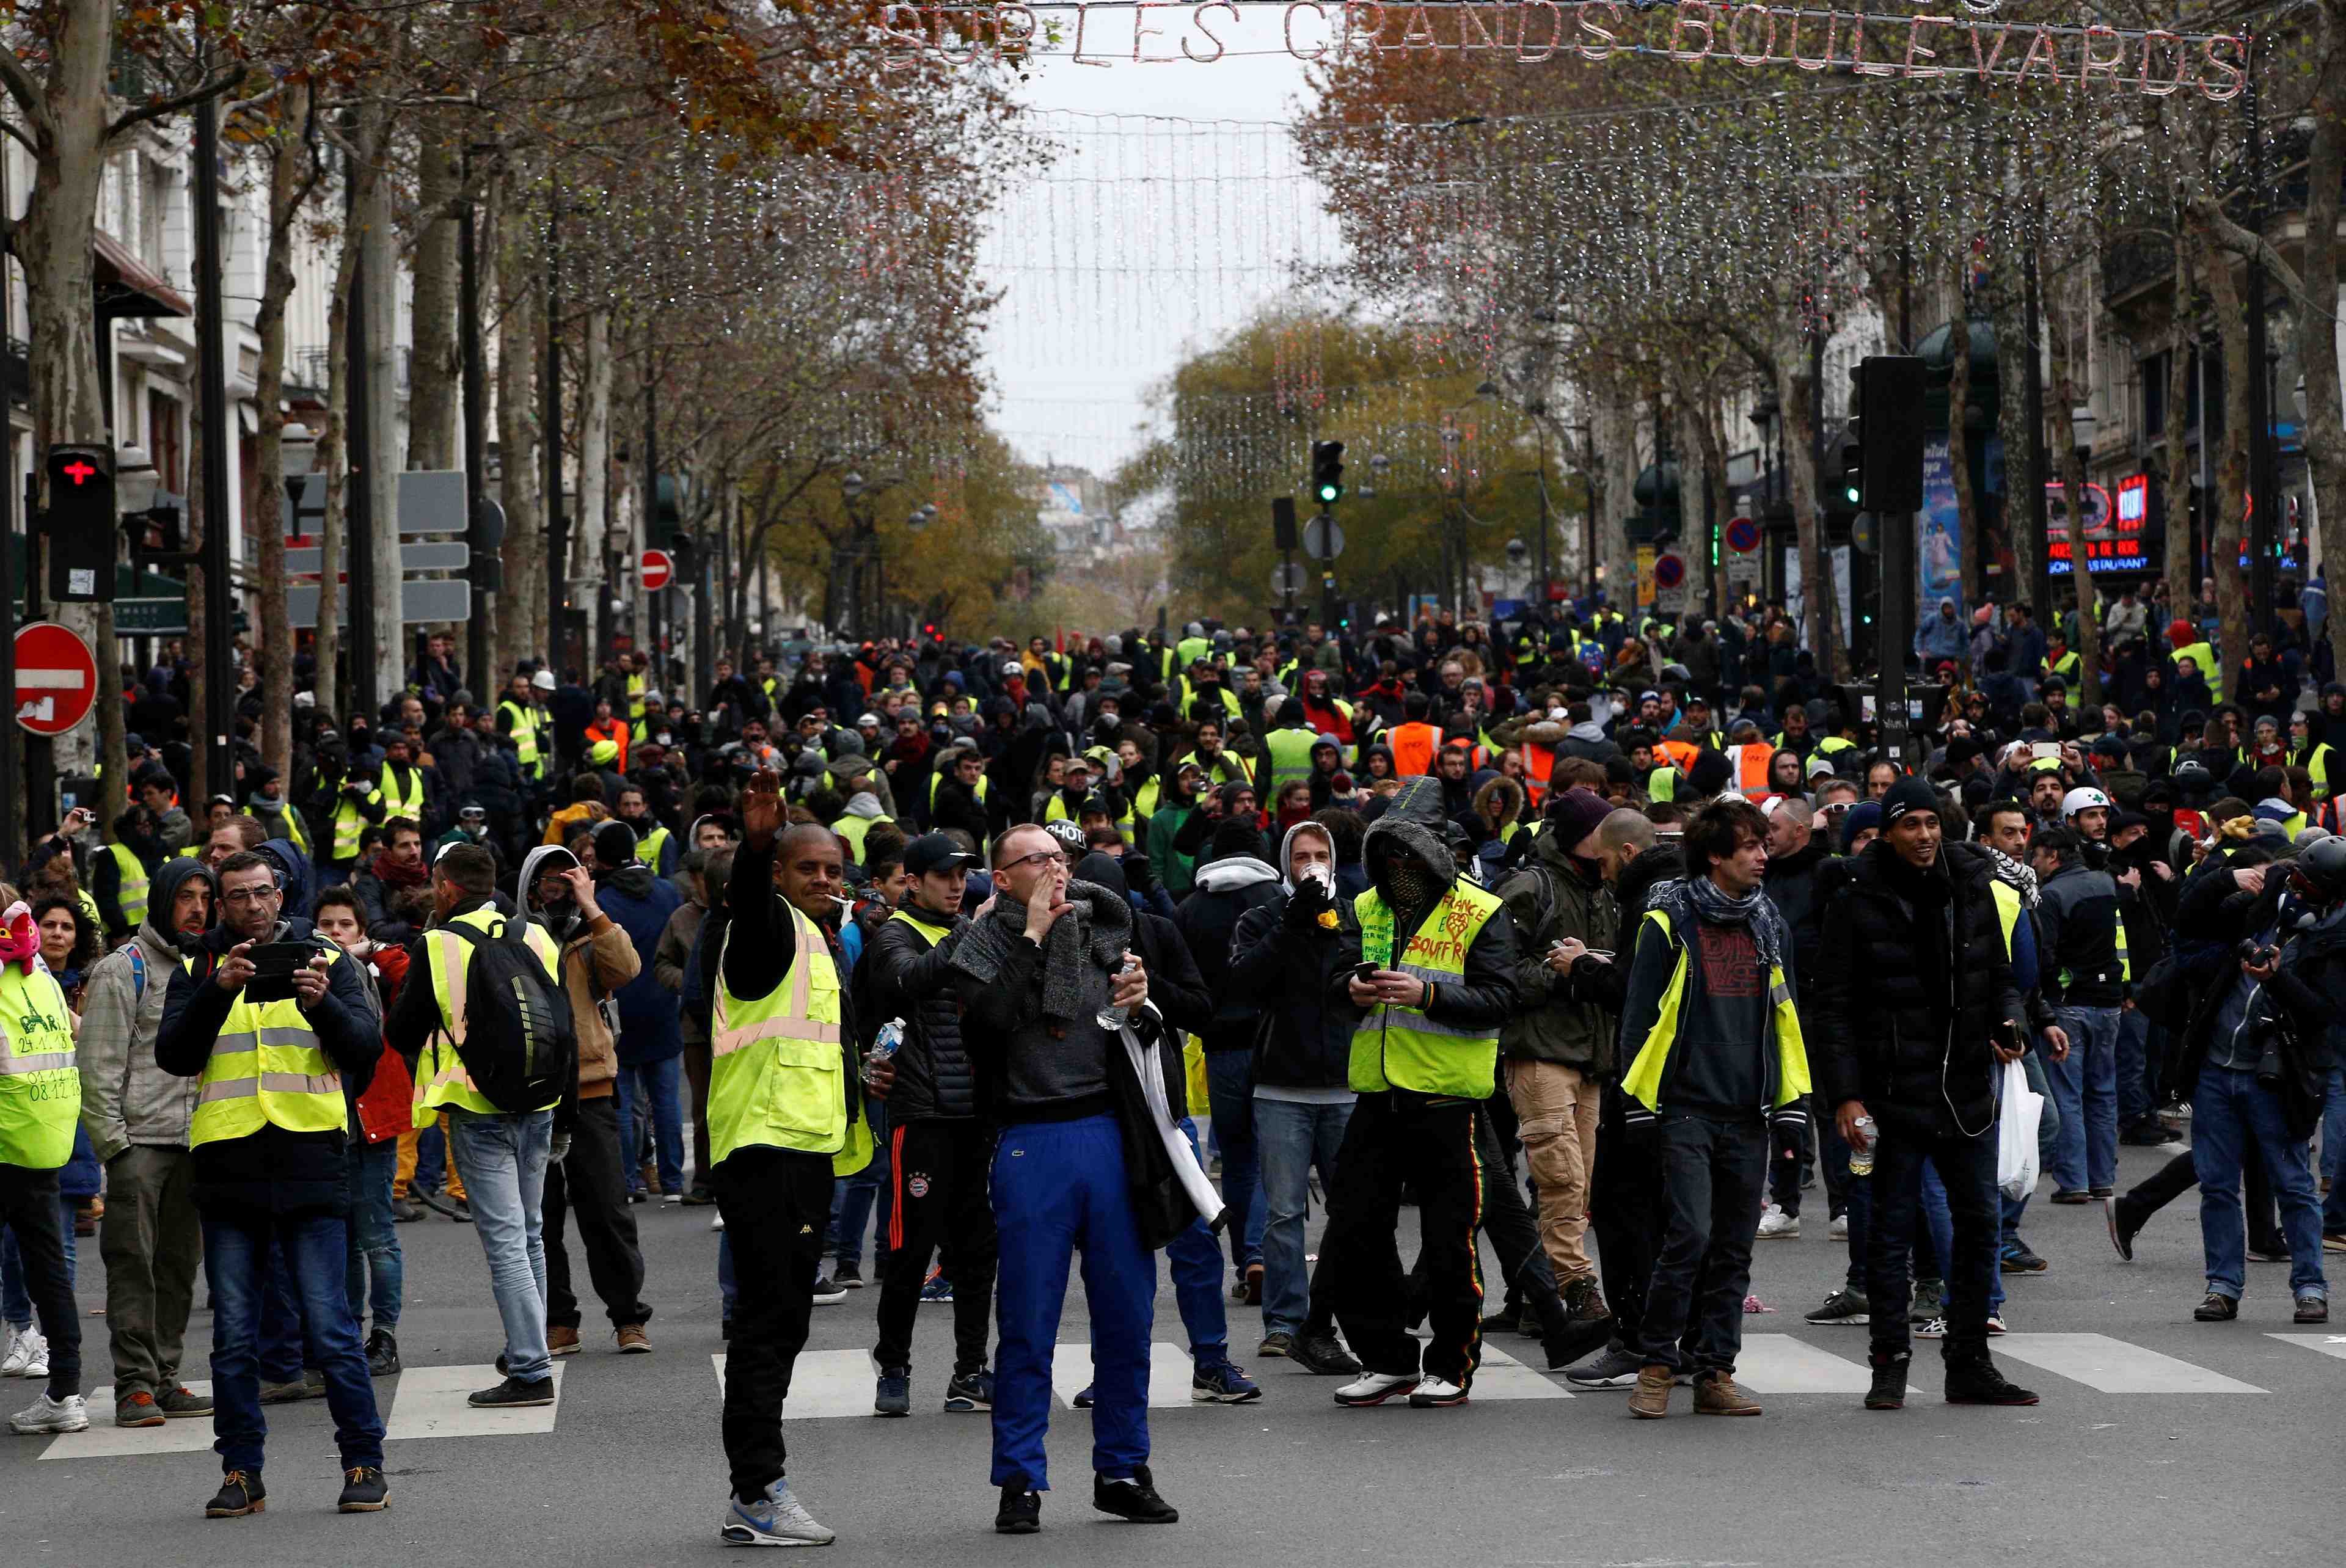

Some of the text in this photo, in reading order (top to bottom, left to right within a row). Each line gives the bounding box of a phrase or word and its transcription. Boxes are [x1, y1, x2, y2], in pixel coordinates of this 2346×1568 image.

[880, 2, 1037, 70] SUR
[1073, 1, 1240, 67] LES
[1669, 0, 2246, 100] BOULEVARDS
[1441, 894, 1487, 922] FRANCE
